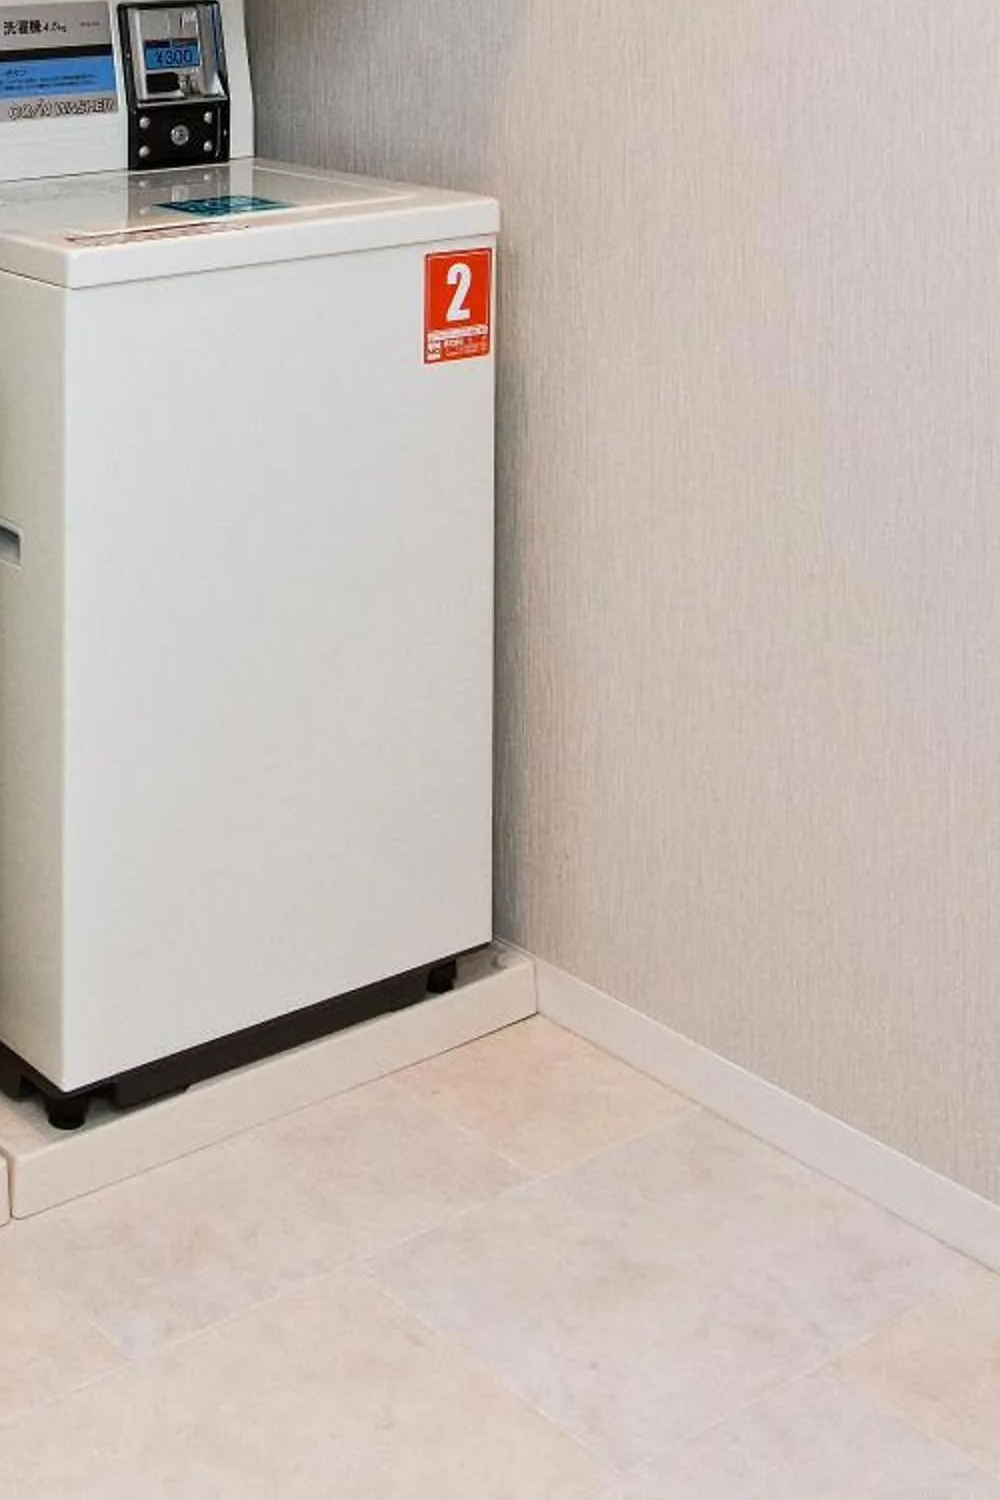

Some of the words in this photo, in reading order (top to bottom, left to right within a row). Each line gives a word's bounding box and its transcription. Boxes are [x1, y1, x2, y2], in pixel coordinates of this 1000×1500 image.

[3, 19, 43, 36] 洗濯機
[446, 262, 472, 322] 2
